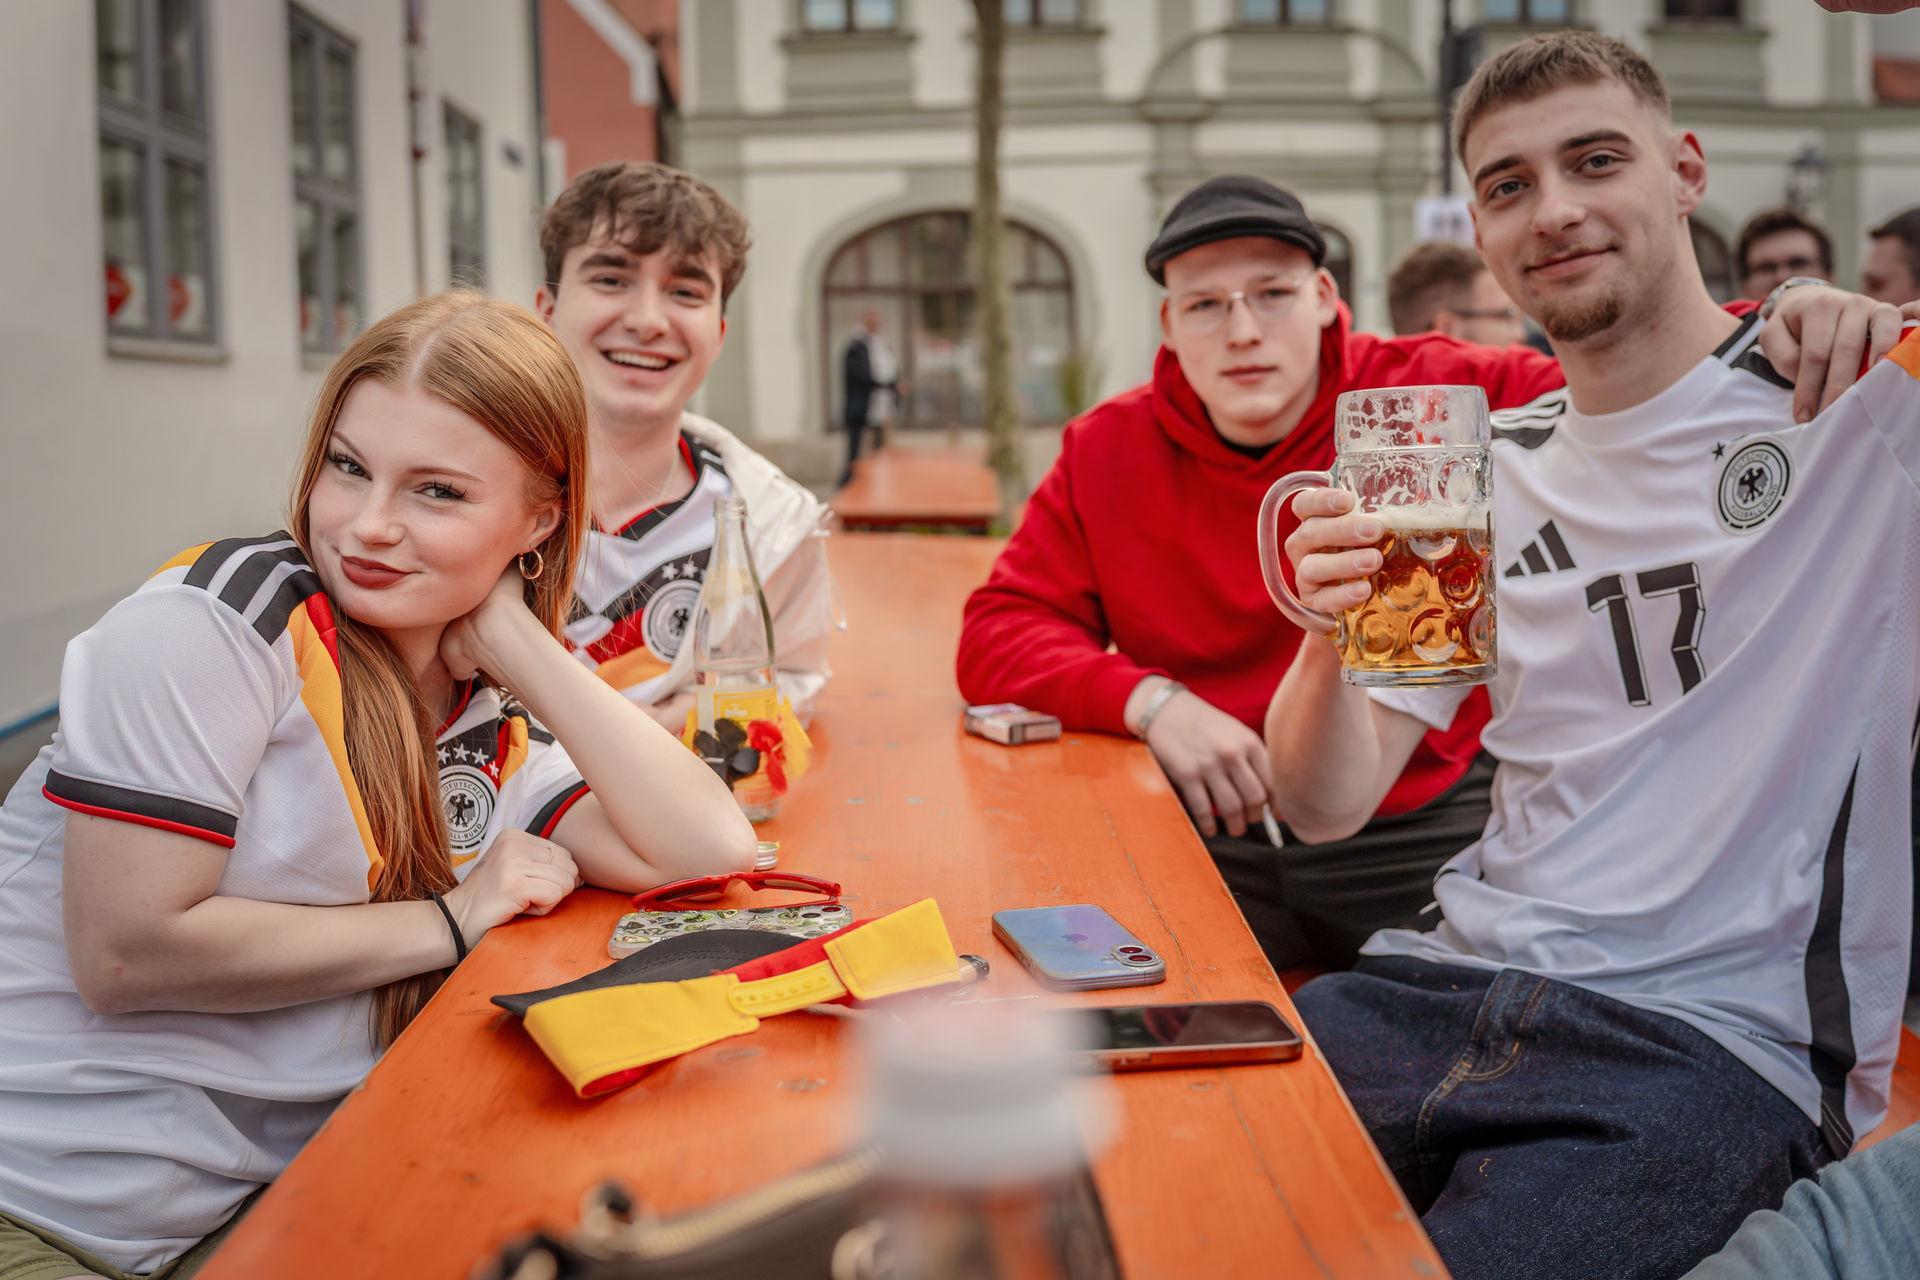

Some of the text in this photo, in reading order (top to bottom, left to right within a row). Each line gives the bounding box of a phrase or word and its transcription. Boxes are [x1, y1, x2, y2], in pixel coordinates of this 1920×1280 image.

[1585, 562, 1707, 707] 17
[443, 781, 484, 800] DEUTSCHER
[449, 823, 483, 840] ALL-BUND
